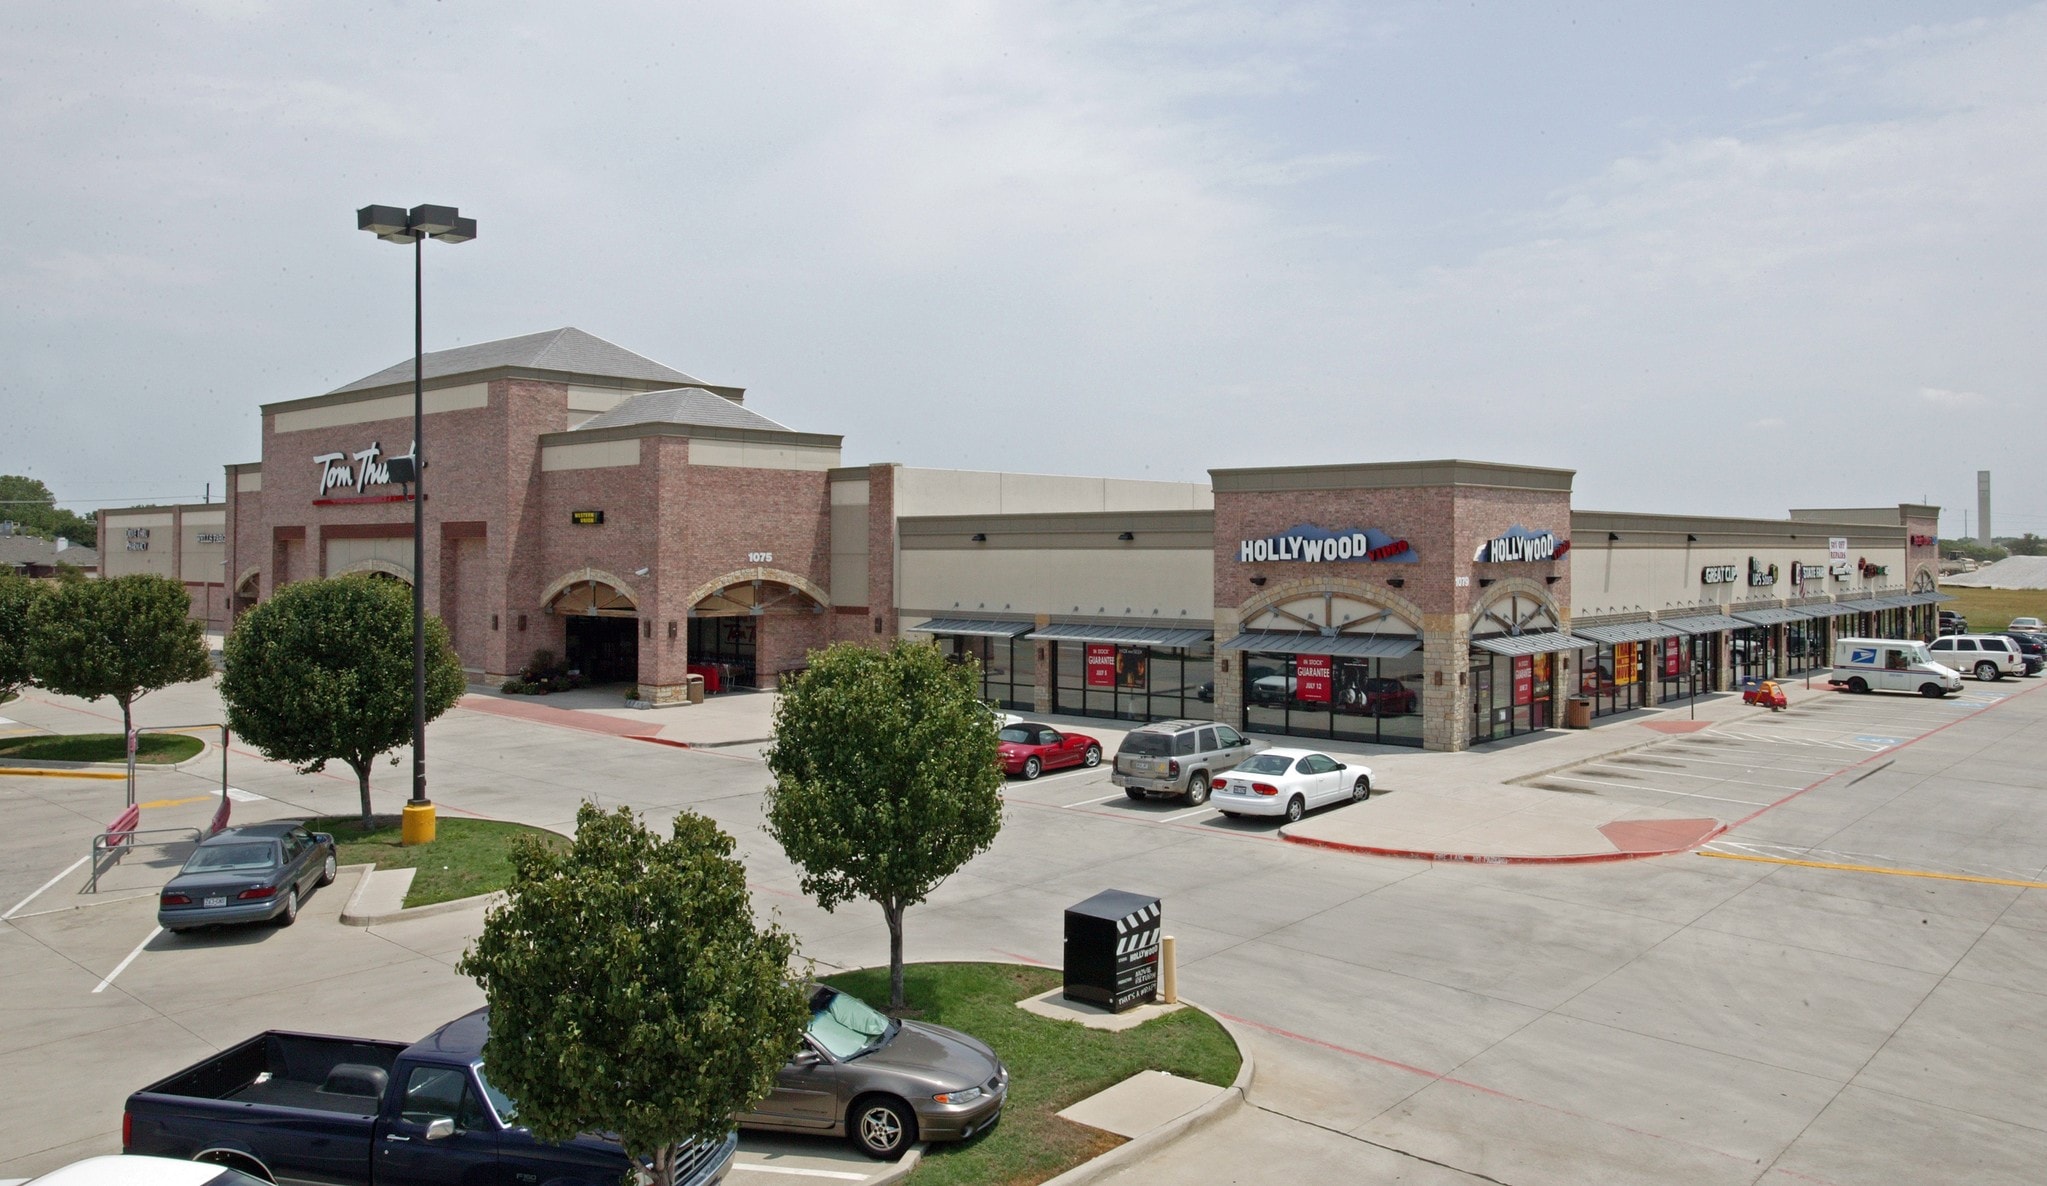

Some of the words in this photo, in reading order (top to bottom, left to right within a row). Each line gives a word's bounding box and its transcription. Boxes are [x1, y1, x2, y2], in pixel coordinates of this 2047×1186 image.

[313, 453, 353, 496] Tom
[352, 440, 426, 494] Thu
[1241, 533, 1367, 563] HOLLYWOOD
[1367, 539, 1410, 562] VIDEO
[1491, 534, 1554, 563] HOLLYWOOD
[748, 552, 773, 563] 1075
[1705, 567, 1725, 584] GREAT
[1088, 656, 1115, 666] GUARANTEE
[1297, 666, 1330, 678] GUARANTEE
[1129, 945, 1158, 962] HOLLYWOOD
[1134, 972, 1156, 985] RETURN
[1135, 967, 1151, 977] MOVIE
[1118, 992, 1136, 1005] THAT'S
